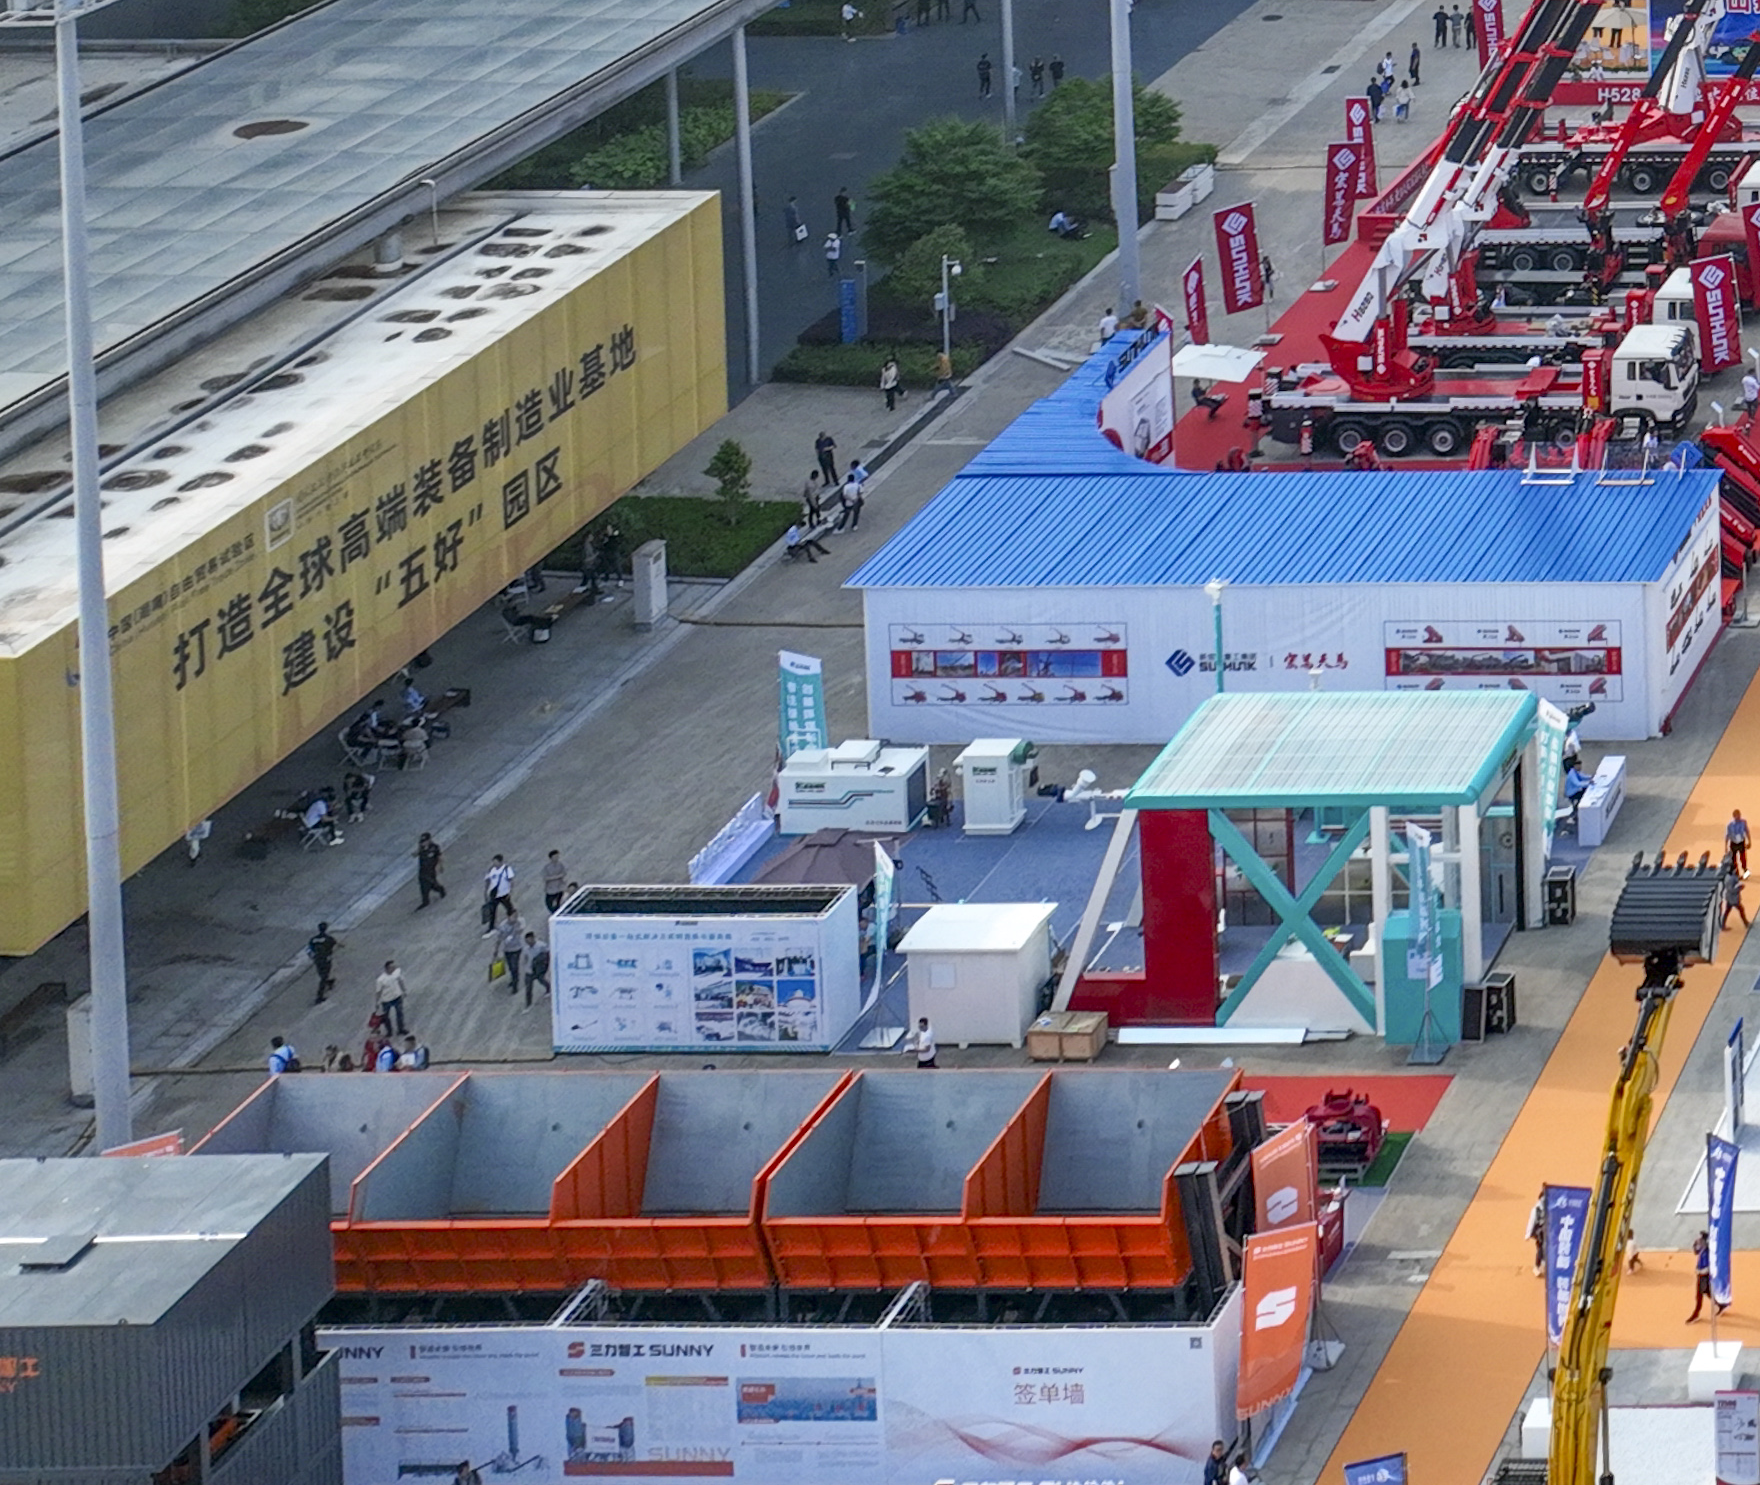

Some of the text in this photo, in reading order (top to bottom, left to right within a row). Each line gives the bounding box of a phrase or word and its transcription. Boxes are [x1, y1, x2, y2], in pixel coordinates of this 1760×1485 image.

[1229, 233, 1253, 307] SUNHUNK
[1707, 288, 1731, 365] SUNHUNK
[174, 323, 637, 692] 打造全球高端装备制造业基地
[281, 600, 357, 697] 建设
[503, 446, 565, 530] 园区
[1199, 661, 1258, 672] SUHUNK
[590, 1343, 714, 1358] 三力智工 SUNNY
[1013, 1381, 1085, 1406] 签单墙
